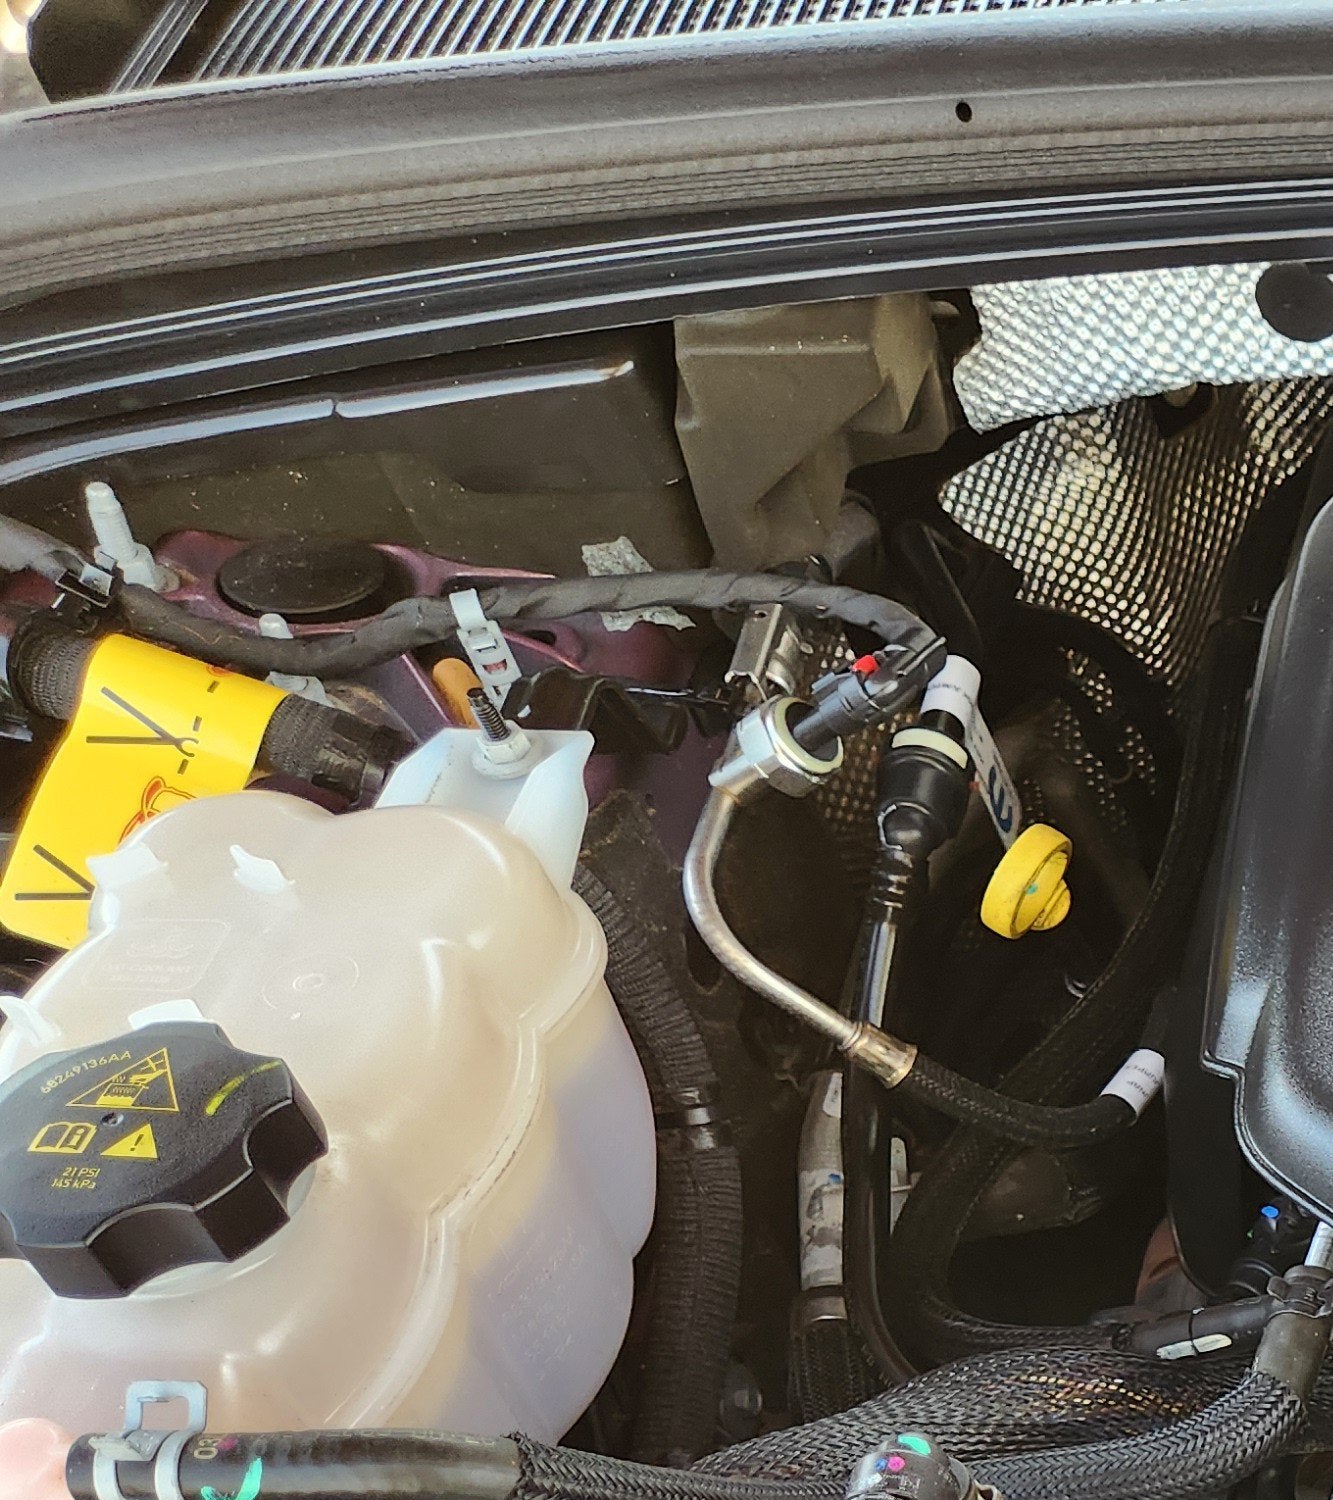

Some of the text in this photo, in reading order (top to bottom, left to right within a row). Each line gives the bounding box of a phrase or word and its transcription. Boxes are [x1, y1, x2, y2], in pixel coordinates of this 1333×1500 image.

[40, 1050, 132, 1094] 68249136AA
[62, 1167, 101, 1178] 21 PSI
[51, 1178, 96, 1189] 145 kPa
